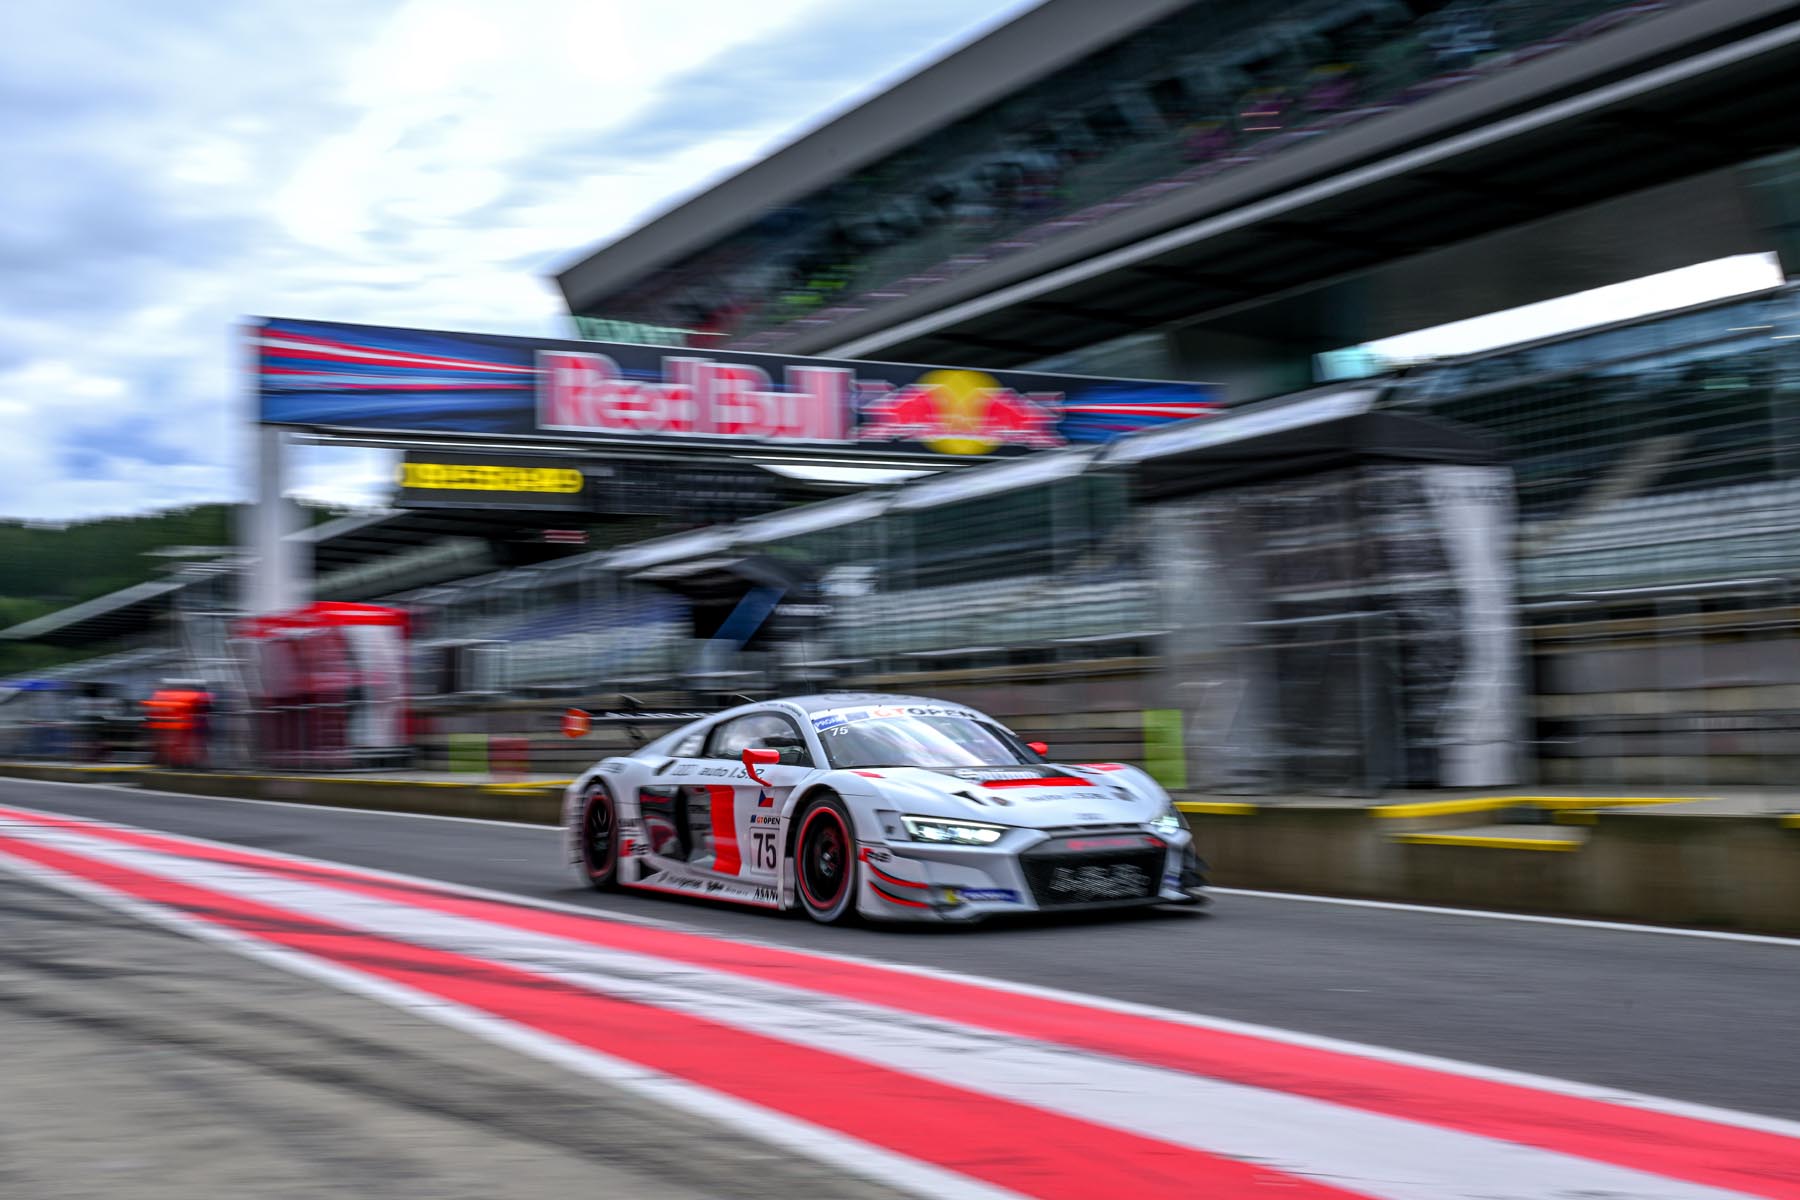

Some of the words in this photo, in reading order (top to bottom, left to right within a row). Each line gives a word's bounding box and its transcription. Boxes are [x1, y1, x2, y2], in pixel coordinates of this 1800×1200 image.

[535, 350, 708, 437] Red
[697, 361, 858, 444] Bull
[831, 726, 848, 737] 75
[753, 832, 777, 869] 75
